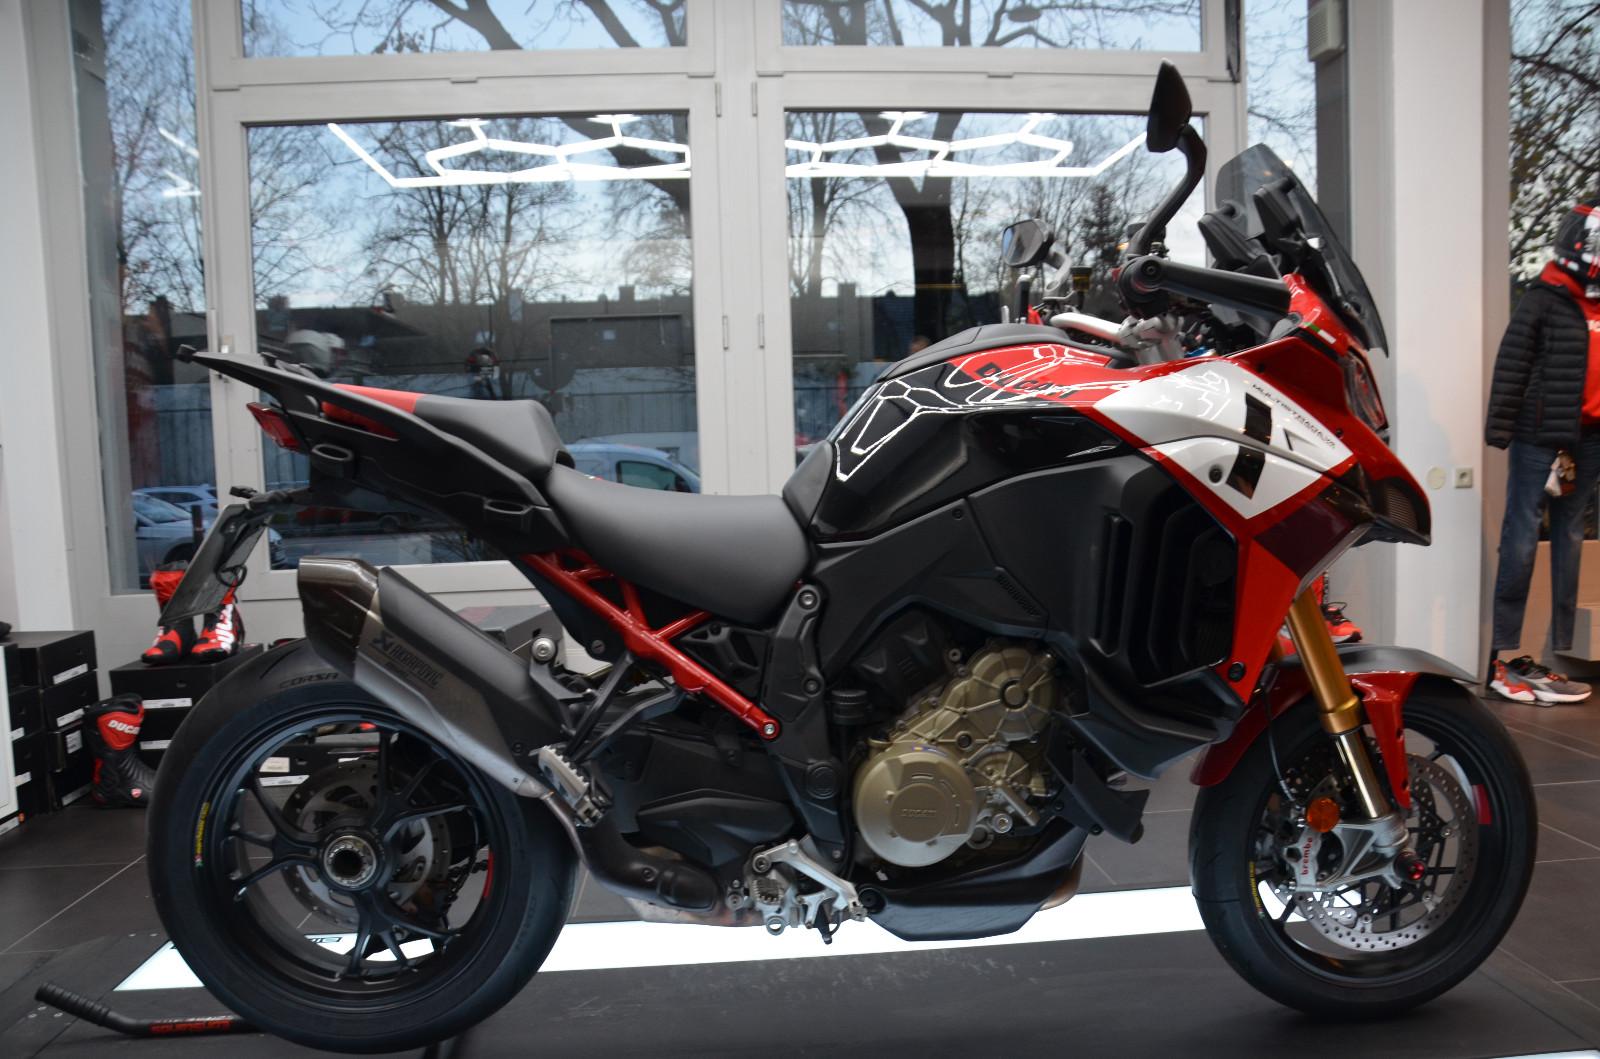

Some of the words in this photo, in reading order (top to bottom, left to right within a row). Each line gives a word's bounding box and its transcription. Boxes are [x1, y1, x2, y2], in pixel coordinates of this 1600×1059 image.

[279, 671, 339, 689] CORSA
[107, 719, 141, 735] DUCA
[1301, 836, 1313, 875] brembo
